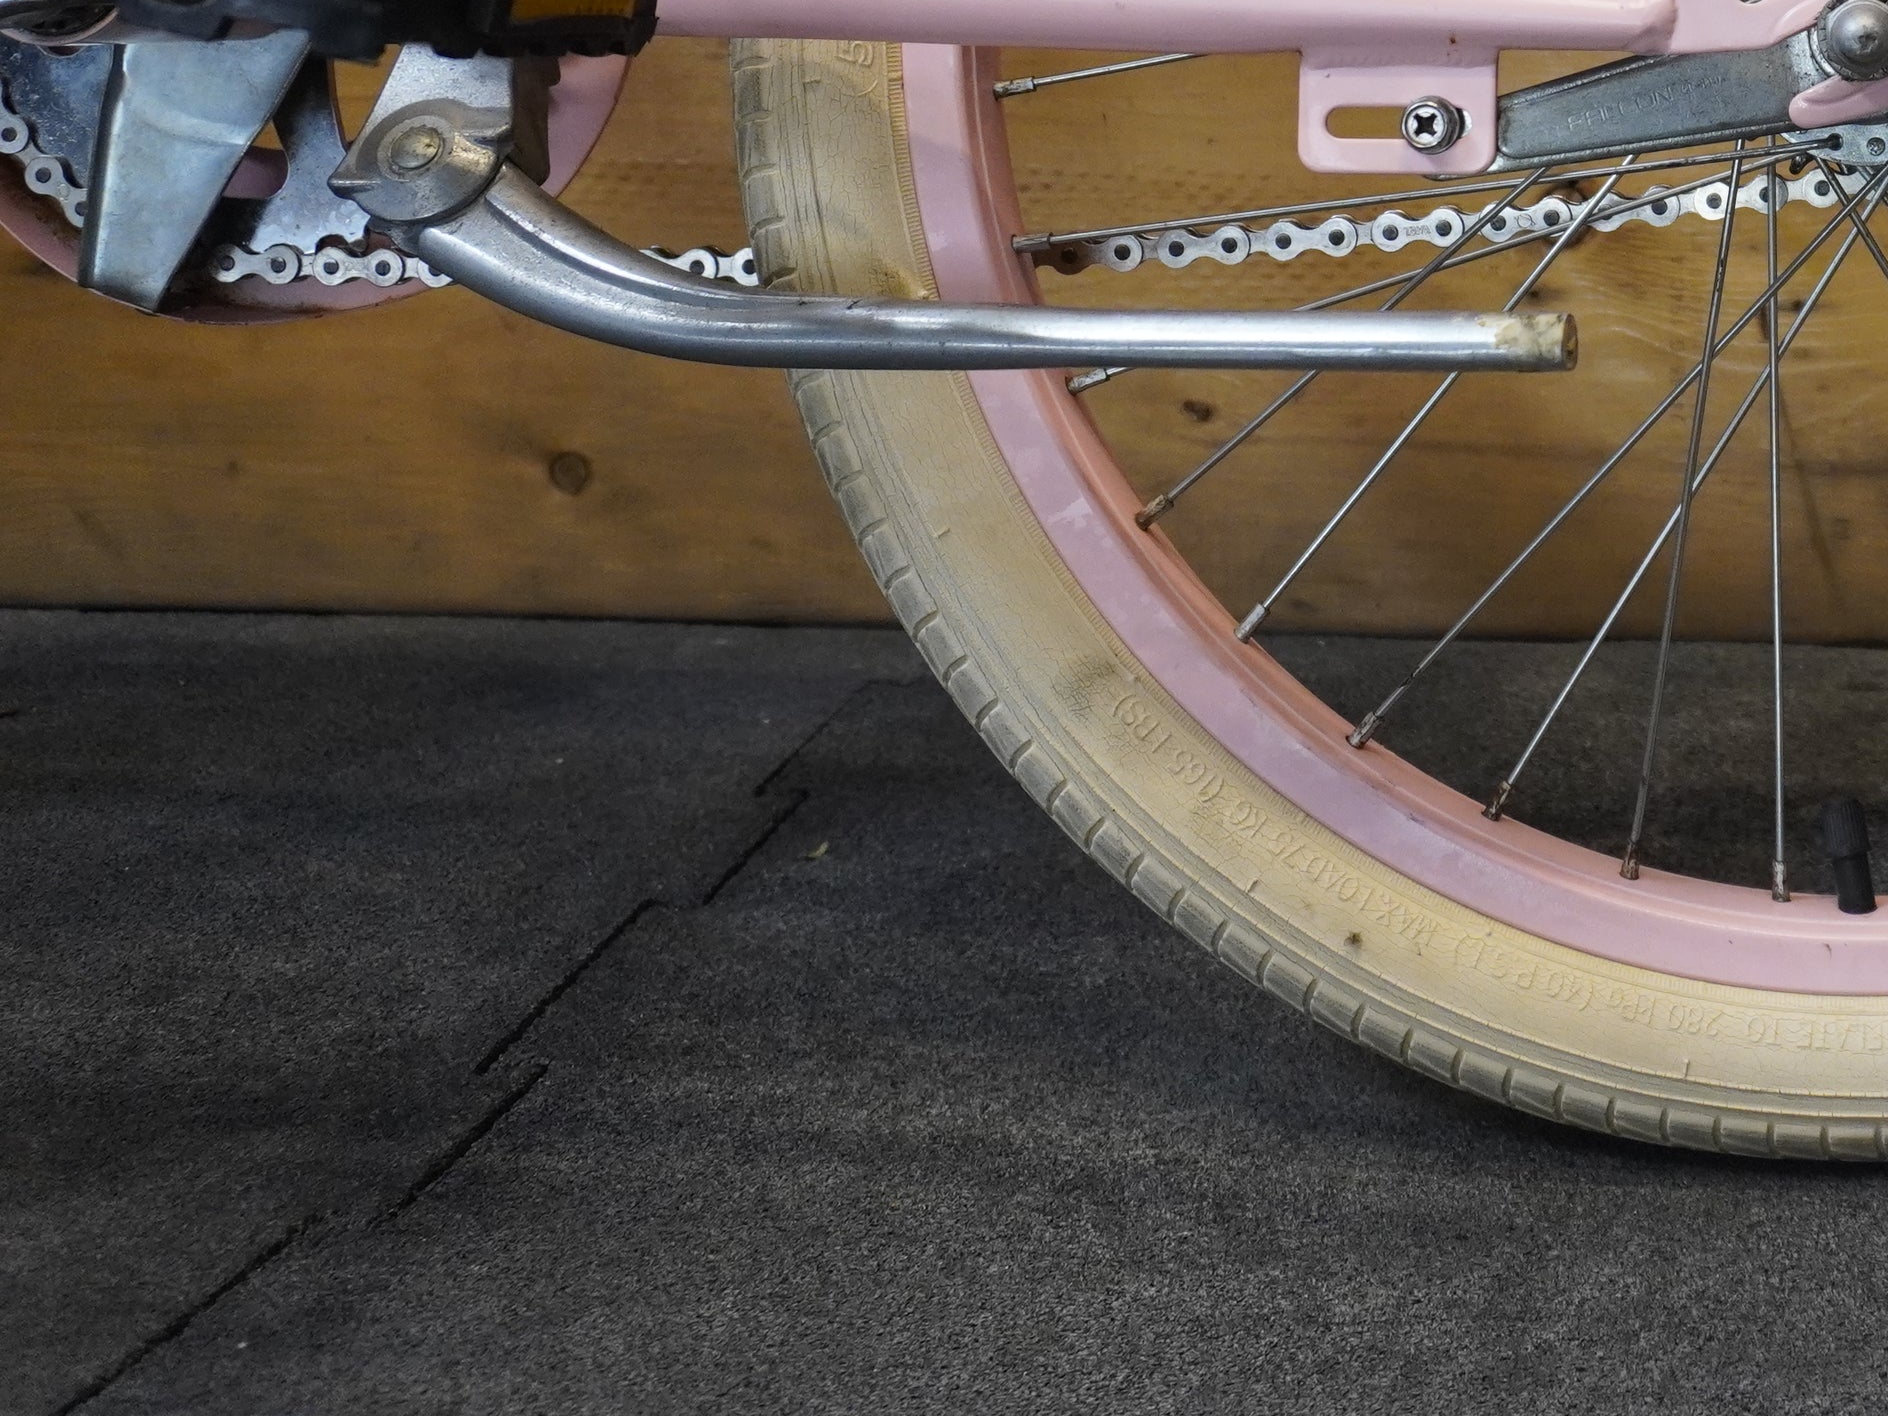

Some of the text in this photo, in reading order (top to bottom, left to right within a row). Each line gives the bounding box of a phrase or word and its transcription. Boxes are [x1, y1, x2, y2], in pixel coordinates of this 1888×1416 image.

[1567, 84, 1676, 131] FALCON
[1164, 747, 1227, 805] (165
[1224, 799, 1268, 842] KG
[1667, 1002, 1722, 1040] 280
